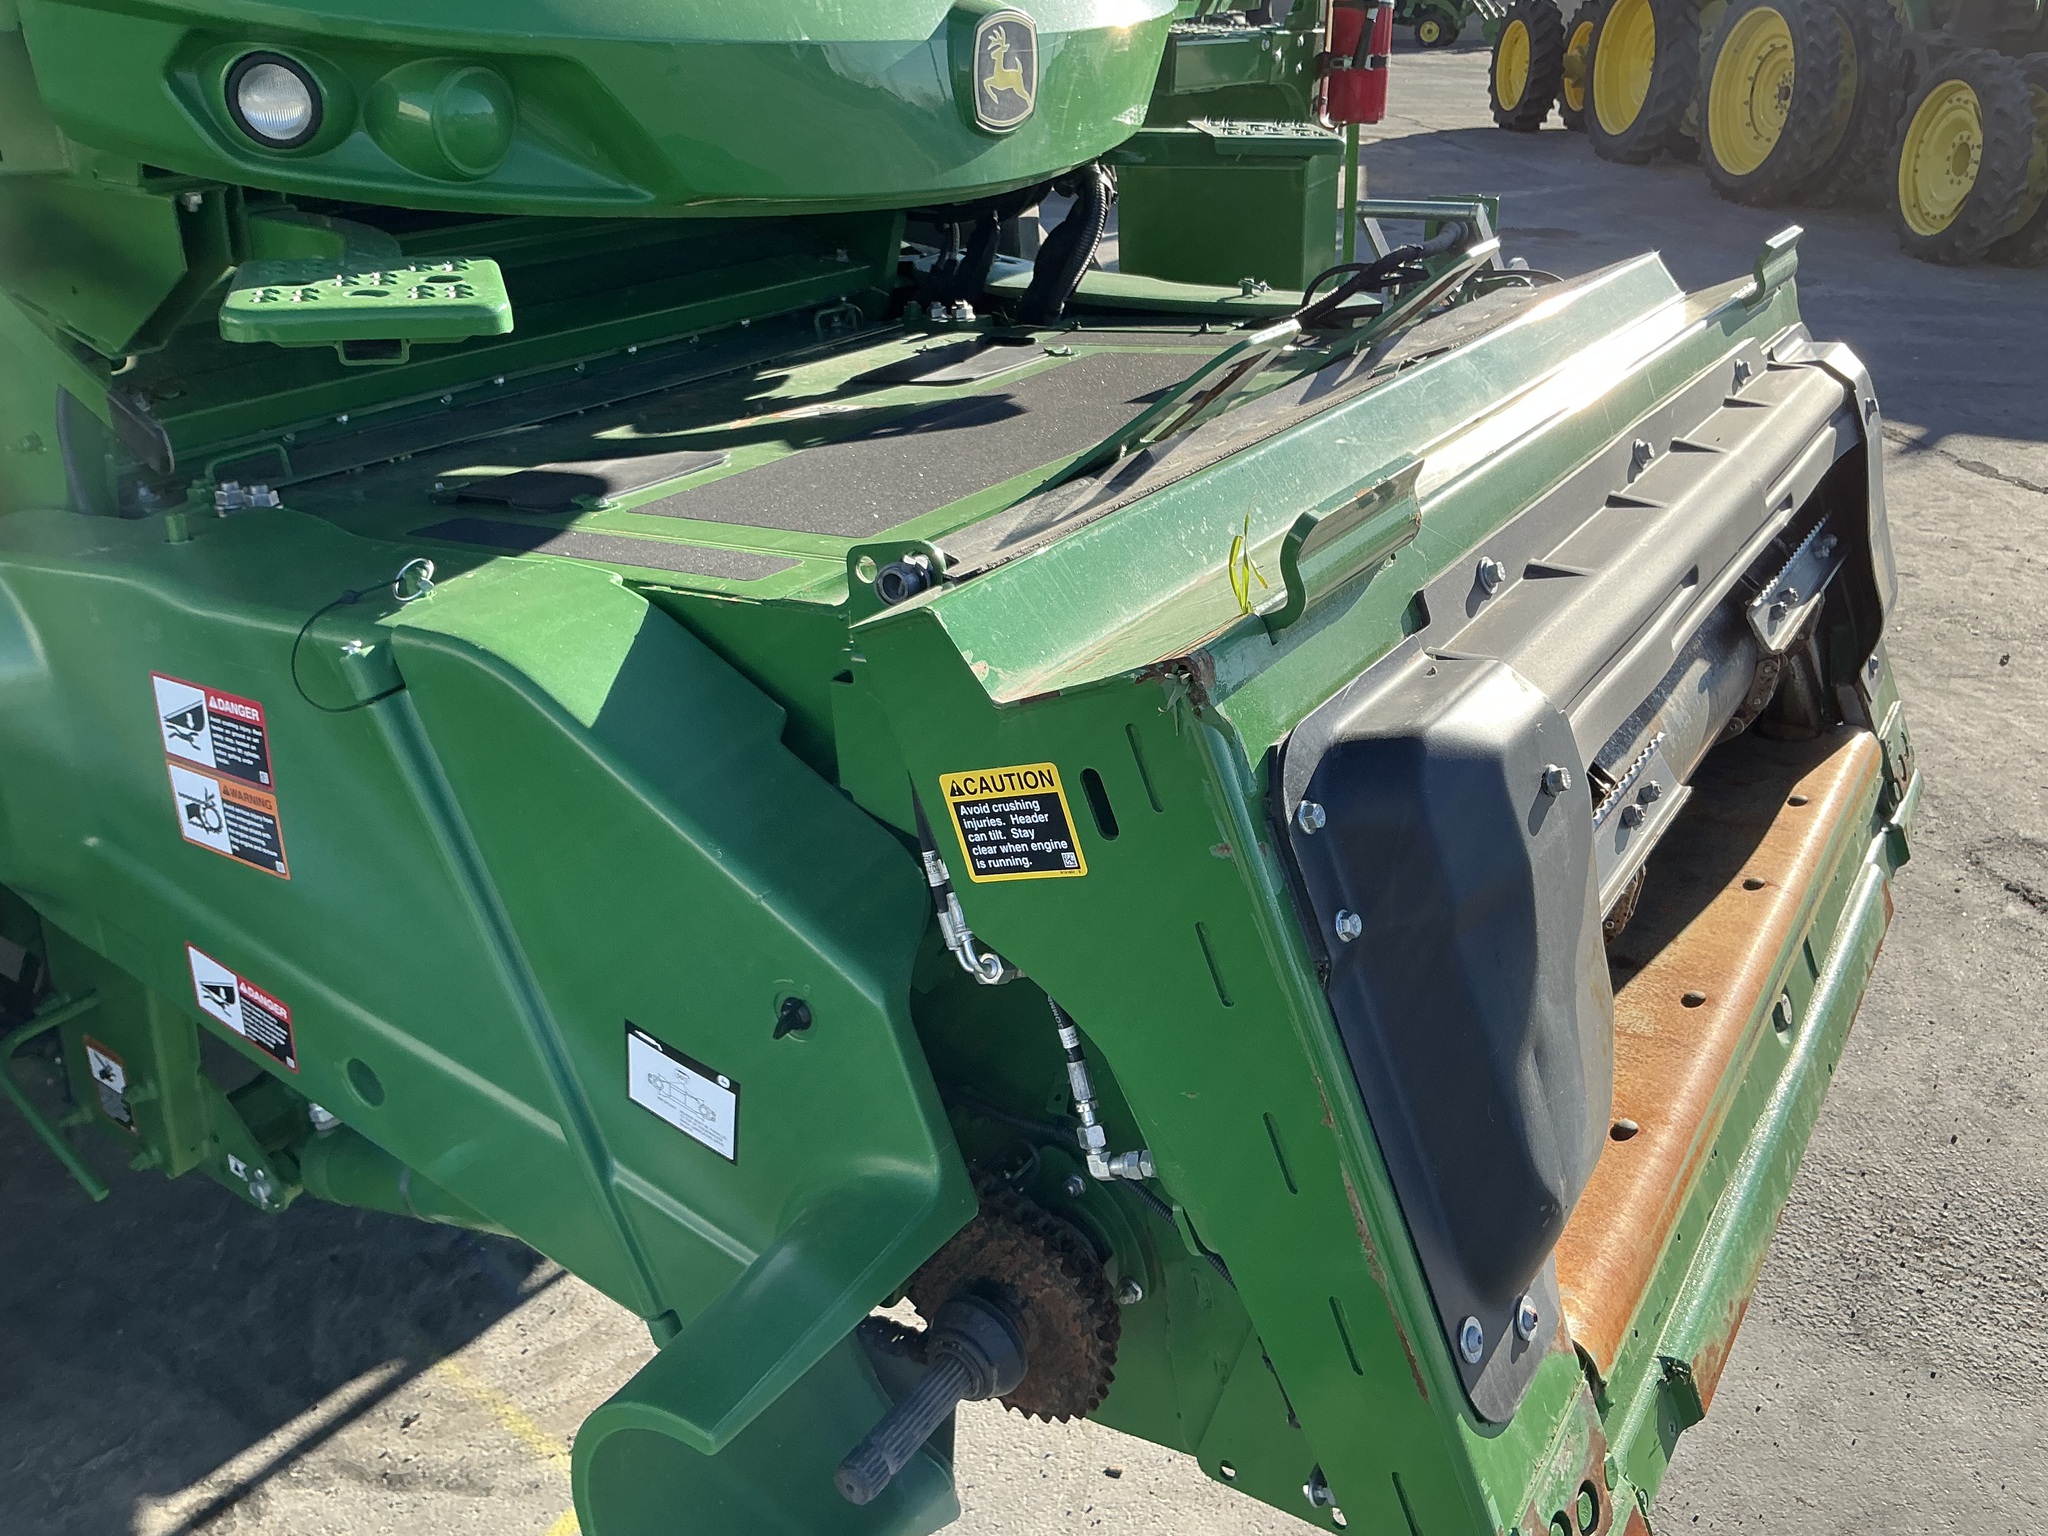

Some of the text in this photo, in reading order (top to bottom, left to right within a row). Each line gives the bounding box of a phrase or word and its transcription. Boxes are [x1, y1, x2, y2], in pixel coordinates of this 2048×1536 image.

[216, 698, 260, 722] DANGER
[963, 769, 1055, 795] CAUTION
[229, 788, 273, 810] WARNING
[960, 799, 1040, 816] Avoid crushing
[963, 813, 1049, 831] injuries. Header
[968, 827, 1035, 842] can tilt. Stay
[972, 838, 1068, 856] clear when engine
[975, 855, 1033, 869] is running.
[247, 986, 288, 1019] DANGER
